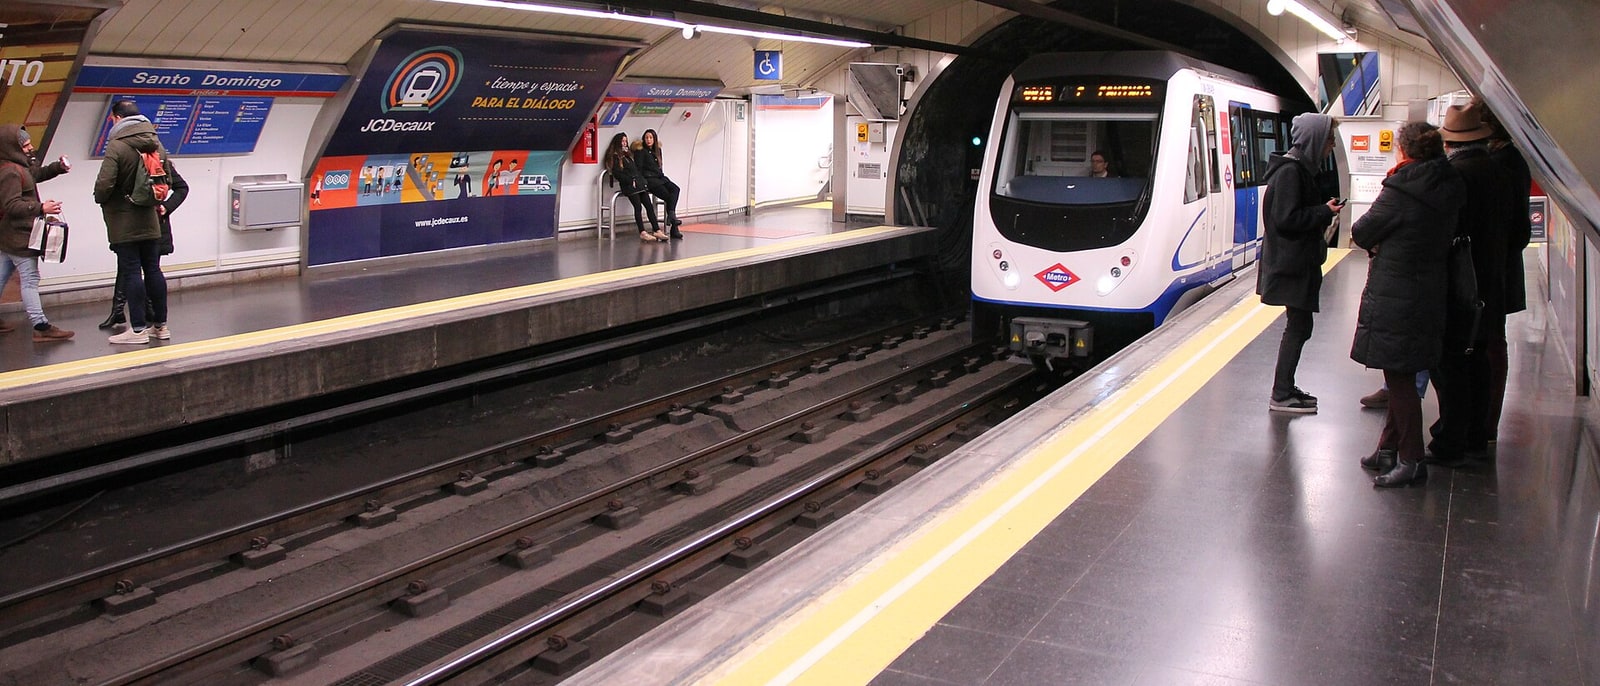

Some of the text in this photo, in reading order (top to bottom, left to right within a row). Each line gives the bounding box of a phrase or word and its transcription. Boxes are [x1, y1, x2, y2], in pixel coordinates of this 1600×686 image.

[132, 72, 282, 89] Santo Domingo
[491, 76, 578, 95] tiempo y espacio
[647, 87, 712, 98] Santo Domingo
[471, 95, 576, 110] PARA EL DIÁLOGO
[360, 118, 436, 132] JCDecaux
[415, 216, 469, 228] www.jcdecaux.es
[1046, 273, 1068, 282] Metro
